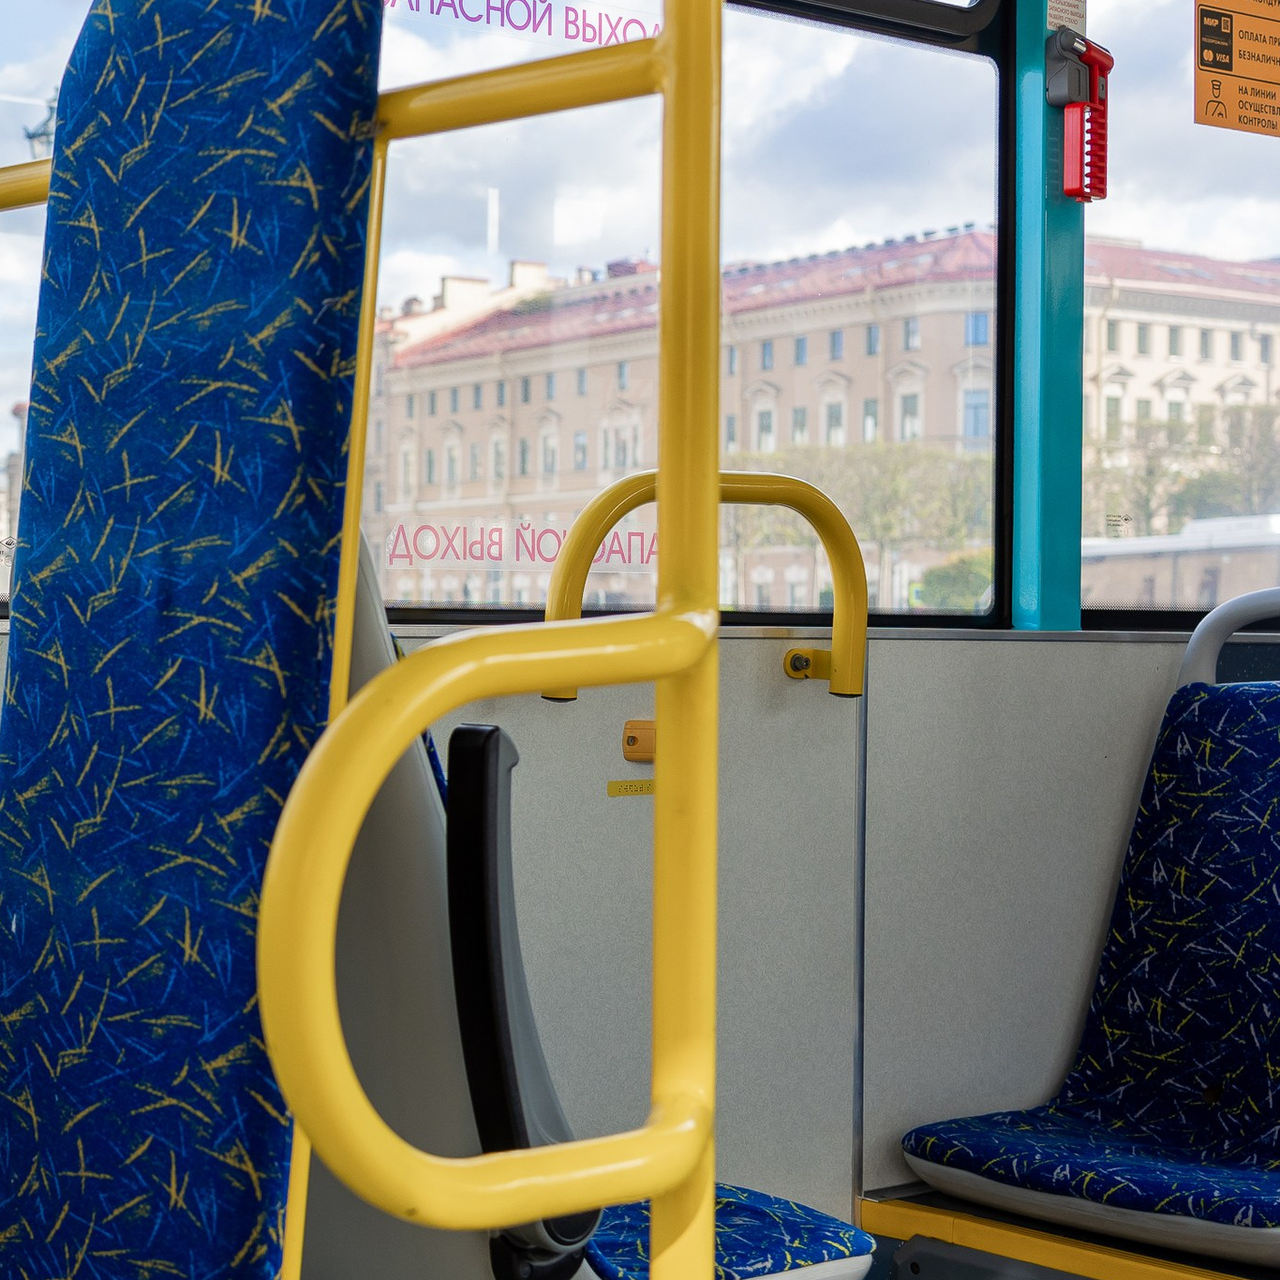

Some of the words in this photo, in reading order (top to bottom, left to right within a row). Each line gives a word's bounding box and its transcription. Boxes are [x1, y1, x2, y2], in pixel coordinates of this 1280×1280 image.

[564, 6, 662, 47] ВЫХО
[1238, 29, 1267, 45] ОПЛАТА
[1216, 53, 1230, 64] VISA
[1238, 85, 1249, 95] НА
[1250, 87, 1276, 101] ЛИНИИ
